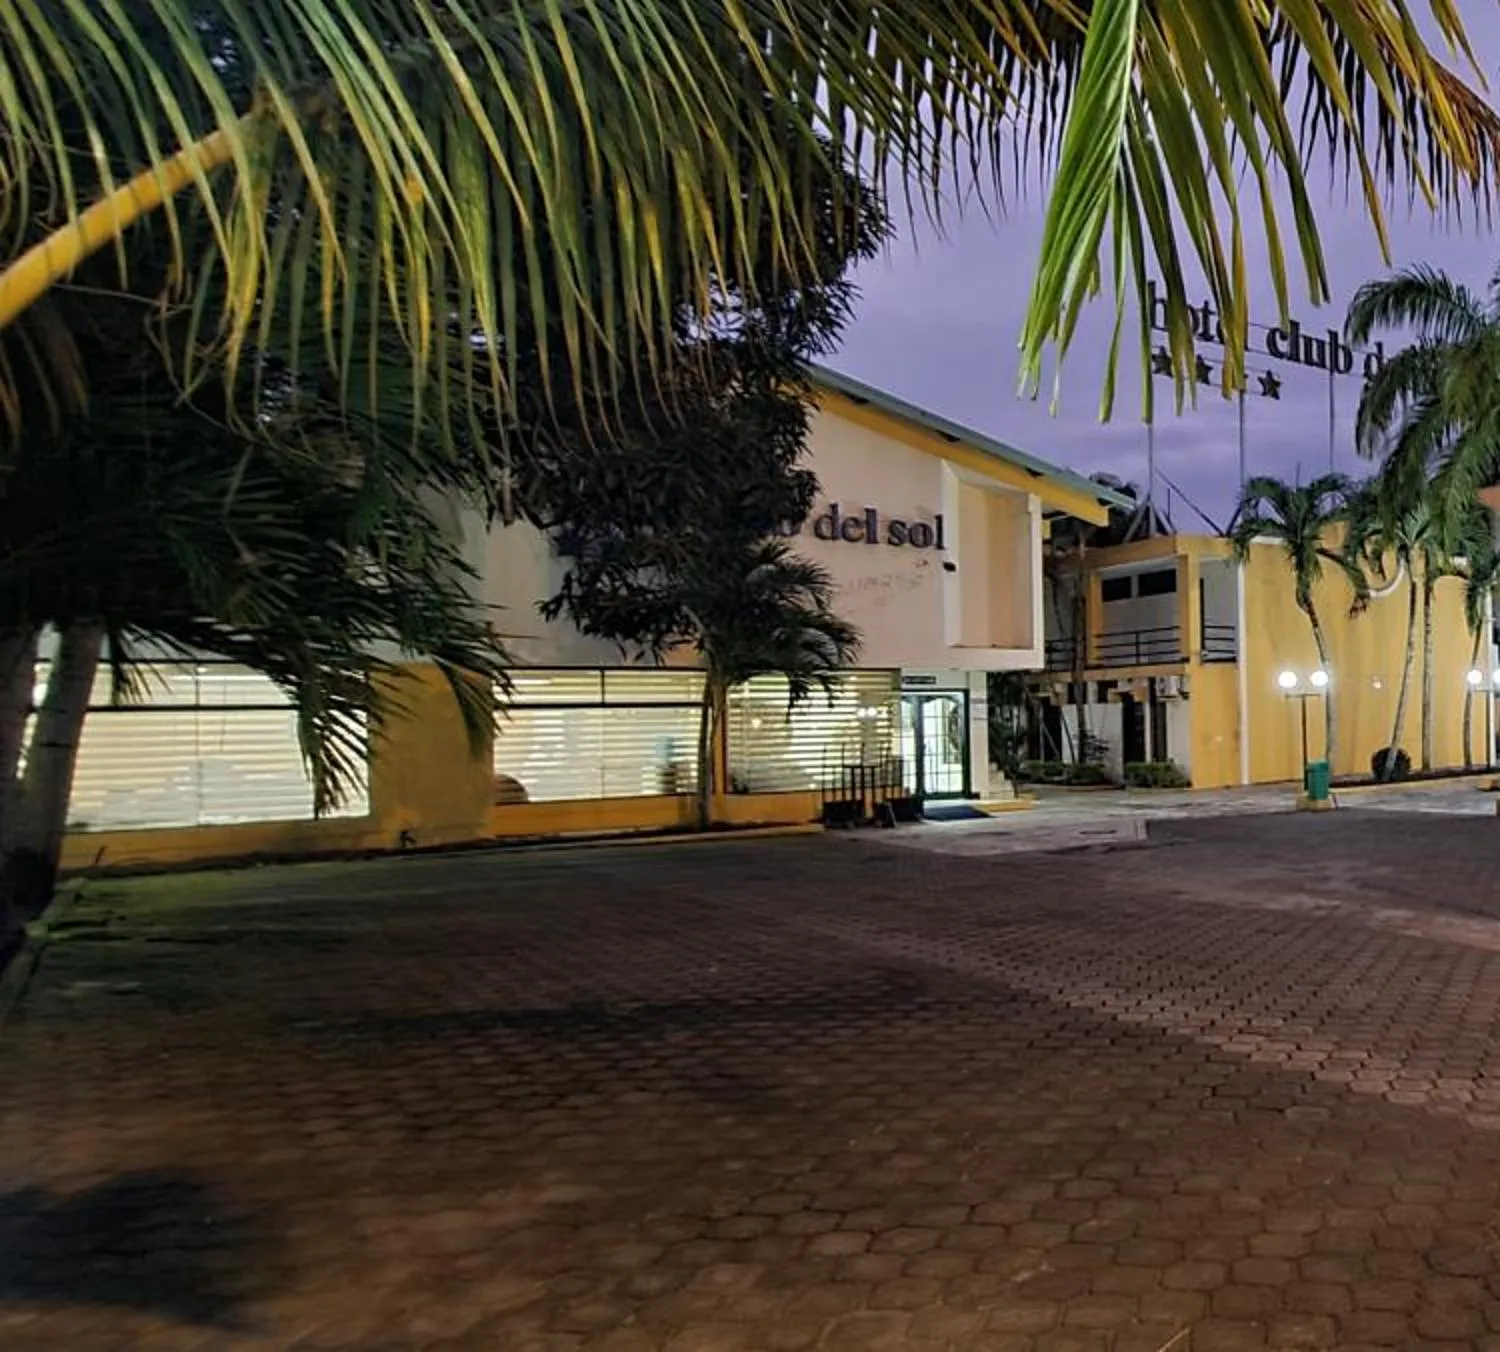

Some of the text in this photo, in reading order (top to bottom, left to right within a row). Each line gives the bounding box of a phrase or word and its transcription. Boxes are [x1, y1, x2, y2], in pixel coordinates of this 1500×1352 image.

[1266, 320, 1353, 374] club
[814, 502, 879, 545] del
[888, 514, 945, 550] sol
